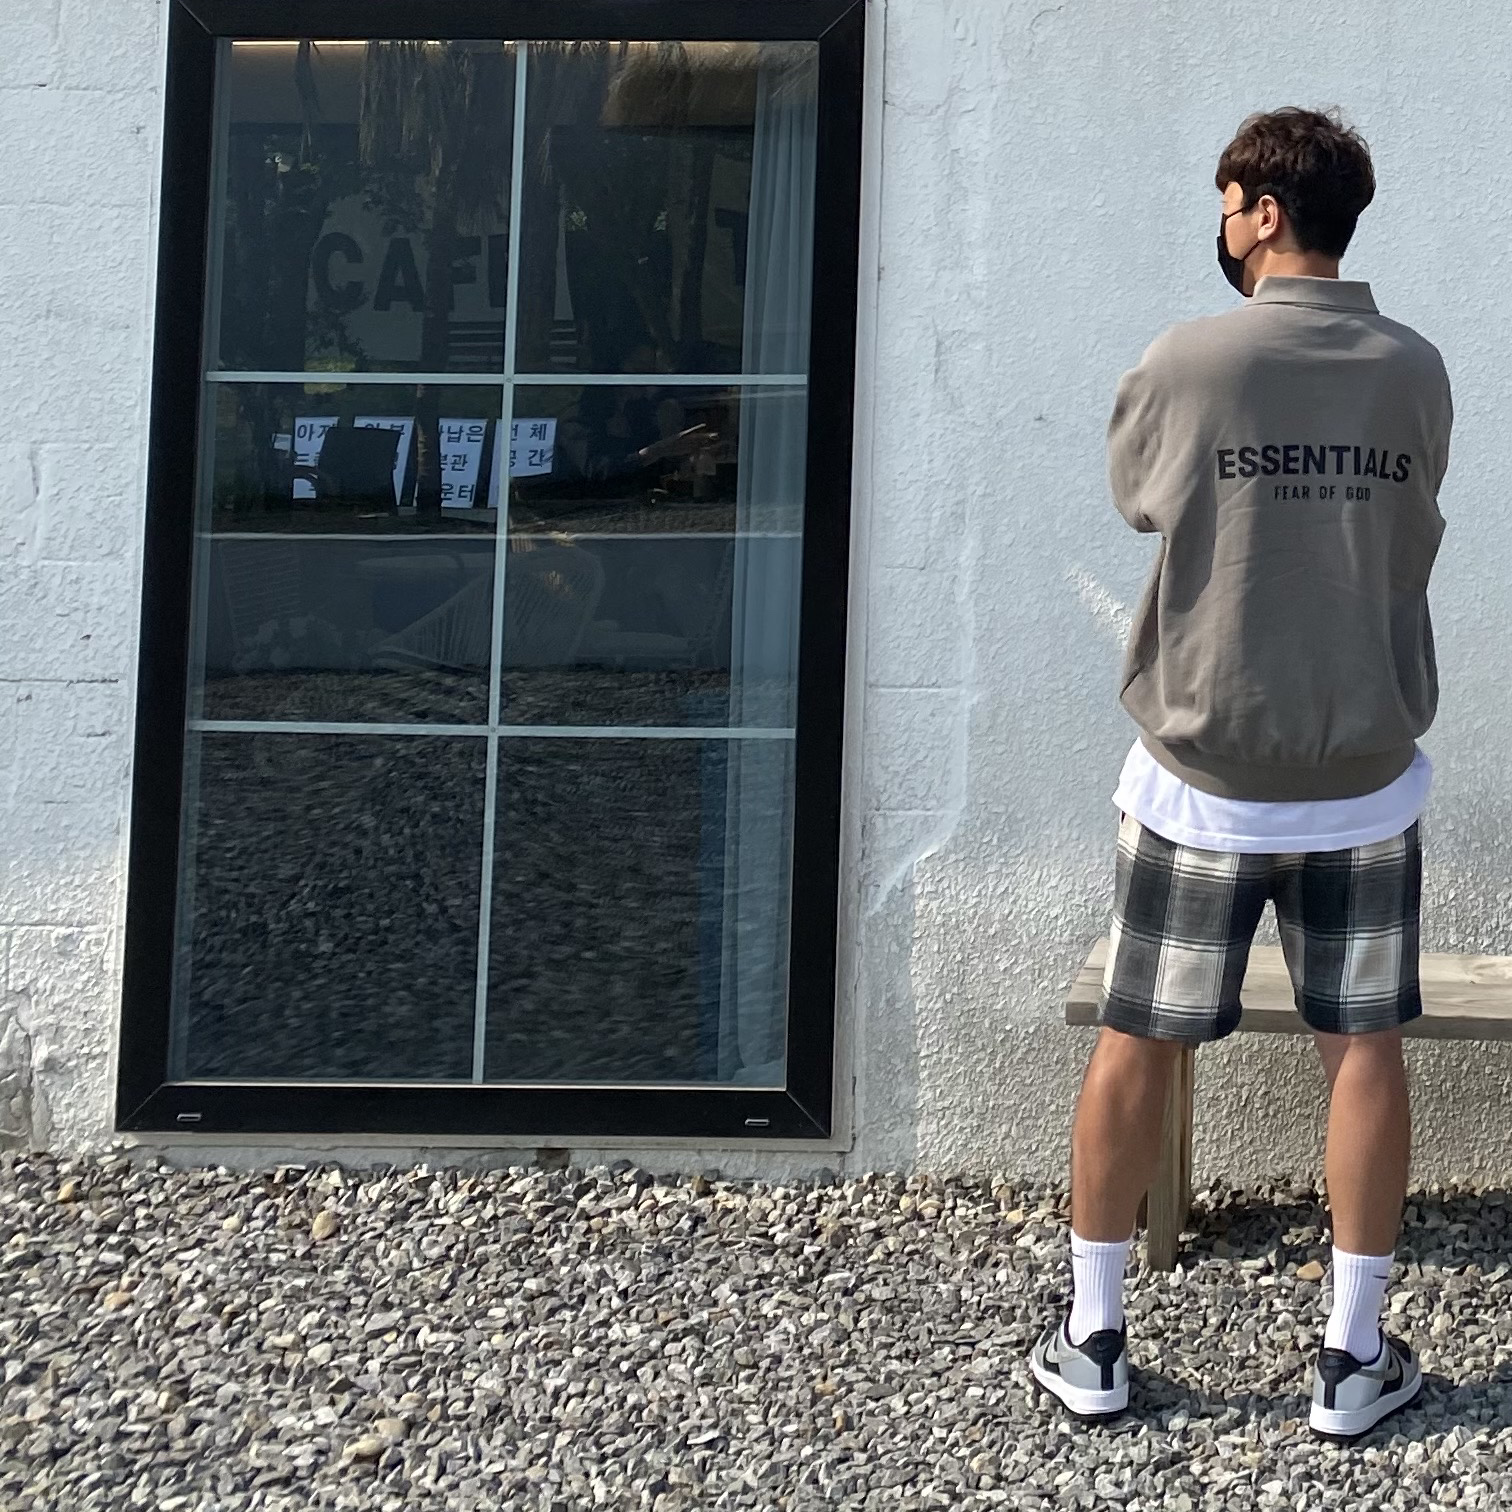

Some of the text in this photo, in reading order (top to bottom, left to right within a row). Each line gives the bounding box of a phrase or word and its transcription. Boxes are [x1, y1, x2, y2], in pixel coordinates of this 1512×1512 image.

[1217, 445, 1411, 482] ESSENTIALS
[1274, 486, 1371, 501] FEAR OF GOD
